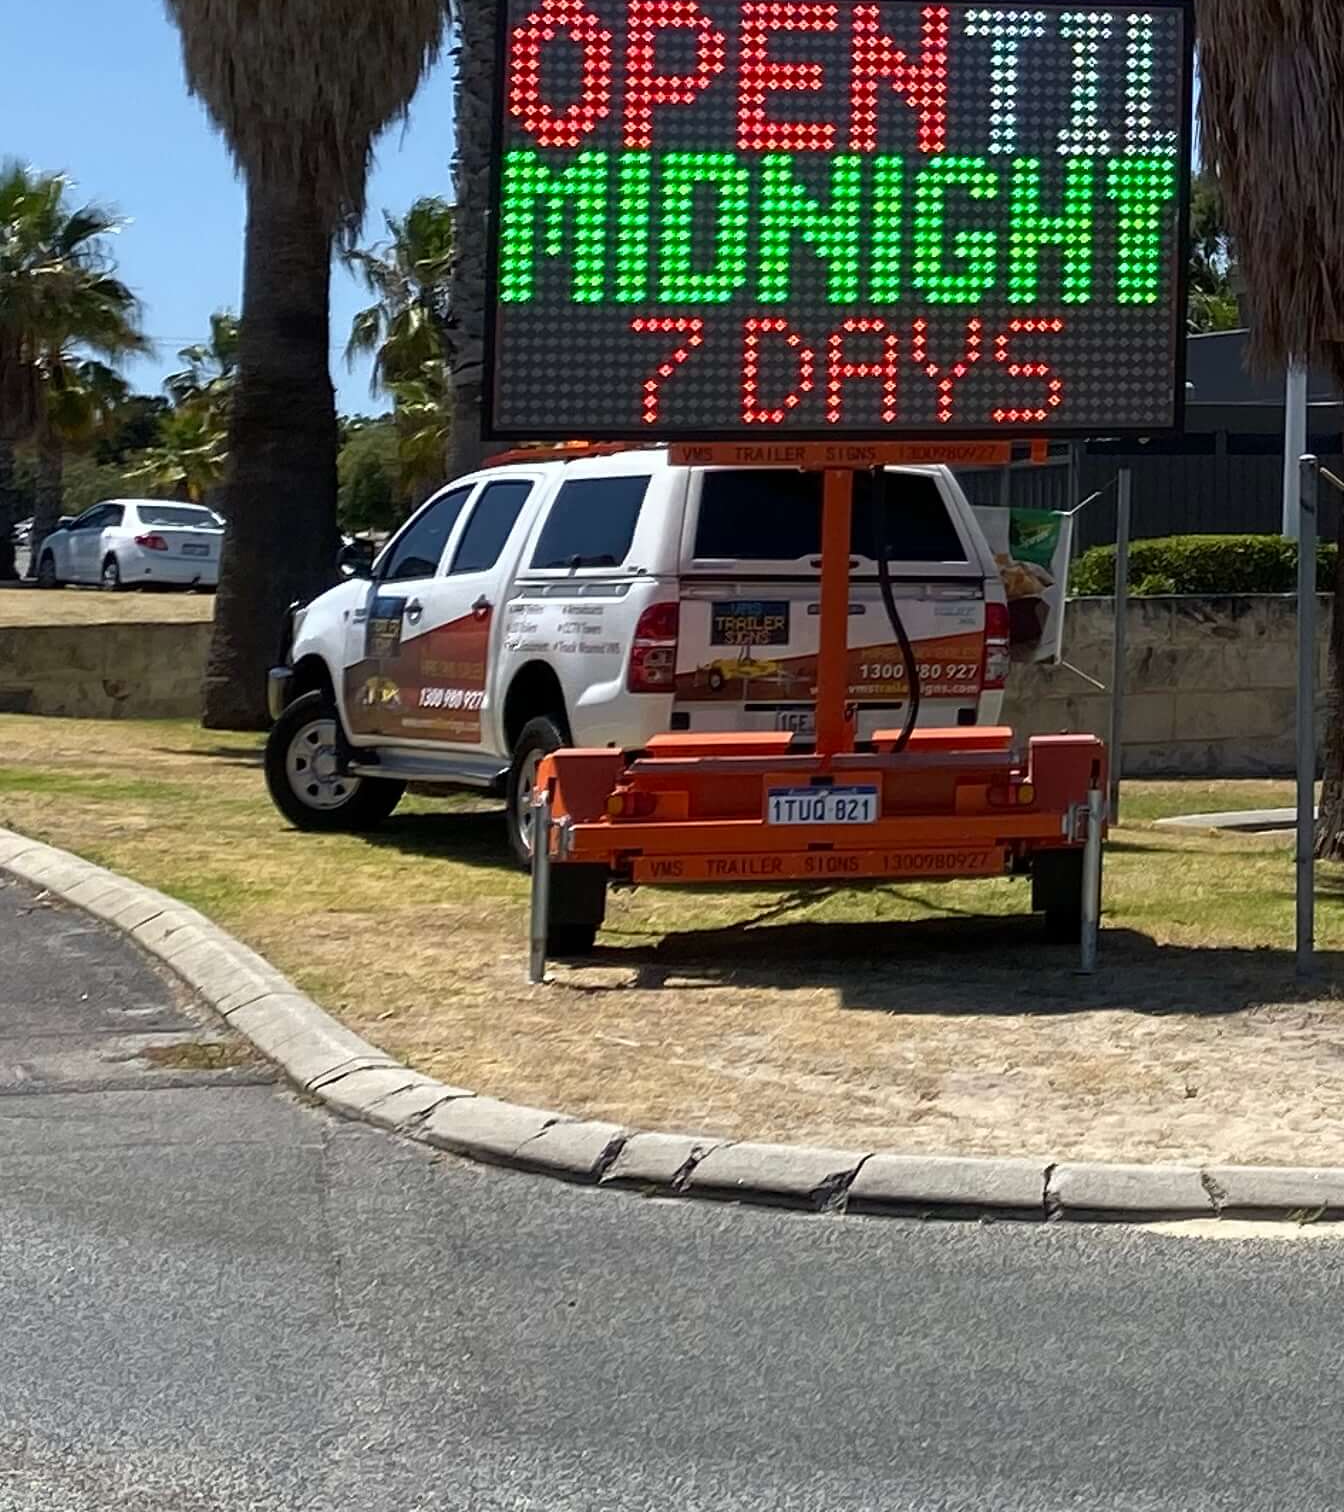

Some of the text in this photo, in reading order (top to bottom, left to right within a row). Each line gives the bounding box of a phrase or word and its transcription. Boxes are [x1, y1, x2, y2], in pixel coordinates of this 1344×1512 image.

[963, 8, 1179, 156] TIL
[500, 149, 1179, 305] MIDNIGHT
[629, 316, 1066, 424] 7 DAYS
[682, 444, 713, 461] VMS
[735, 443, 806, 461] TRAILER
[825, 445, 877, 461] SIGNS
[715, 616, 785, 631] TRAILER
[723, 630, 769, 645] SIGNS
[859, 662, 978, 679] 1300 80 927
[650, 853, 989, 877] VMS TRAILER SIGNS 1300980927
